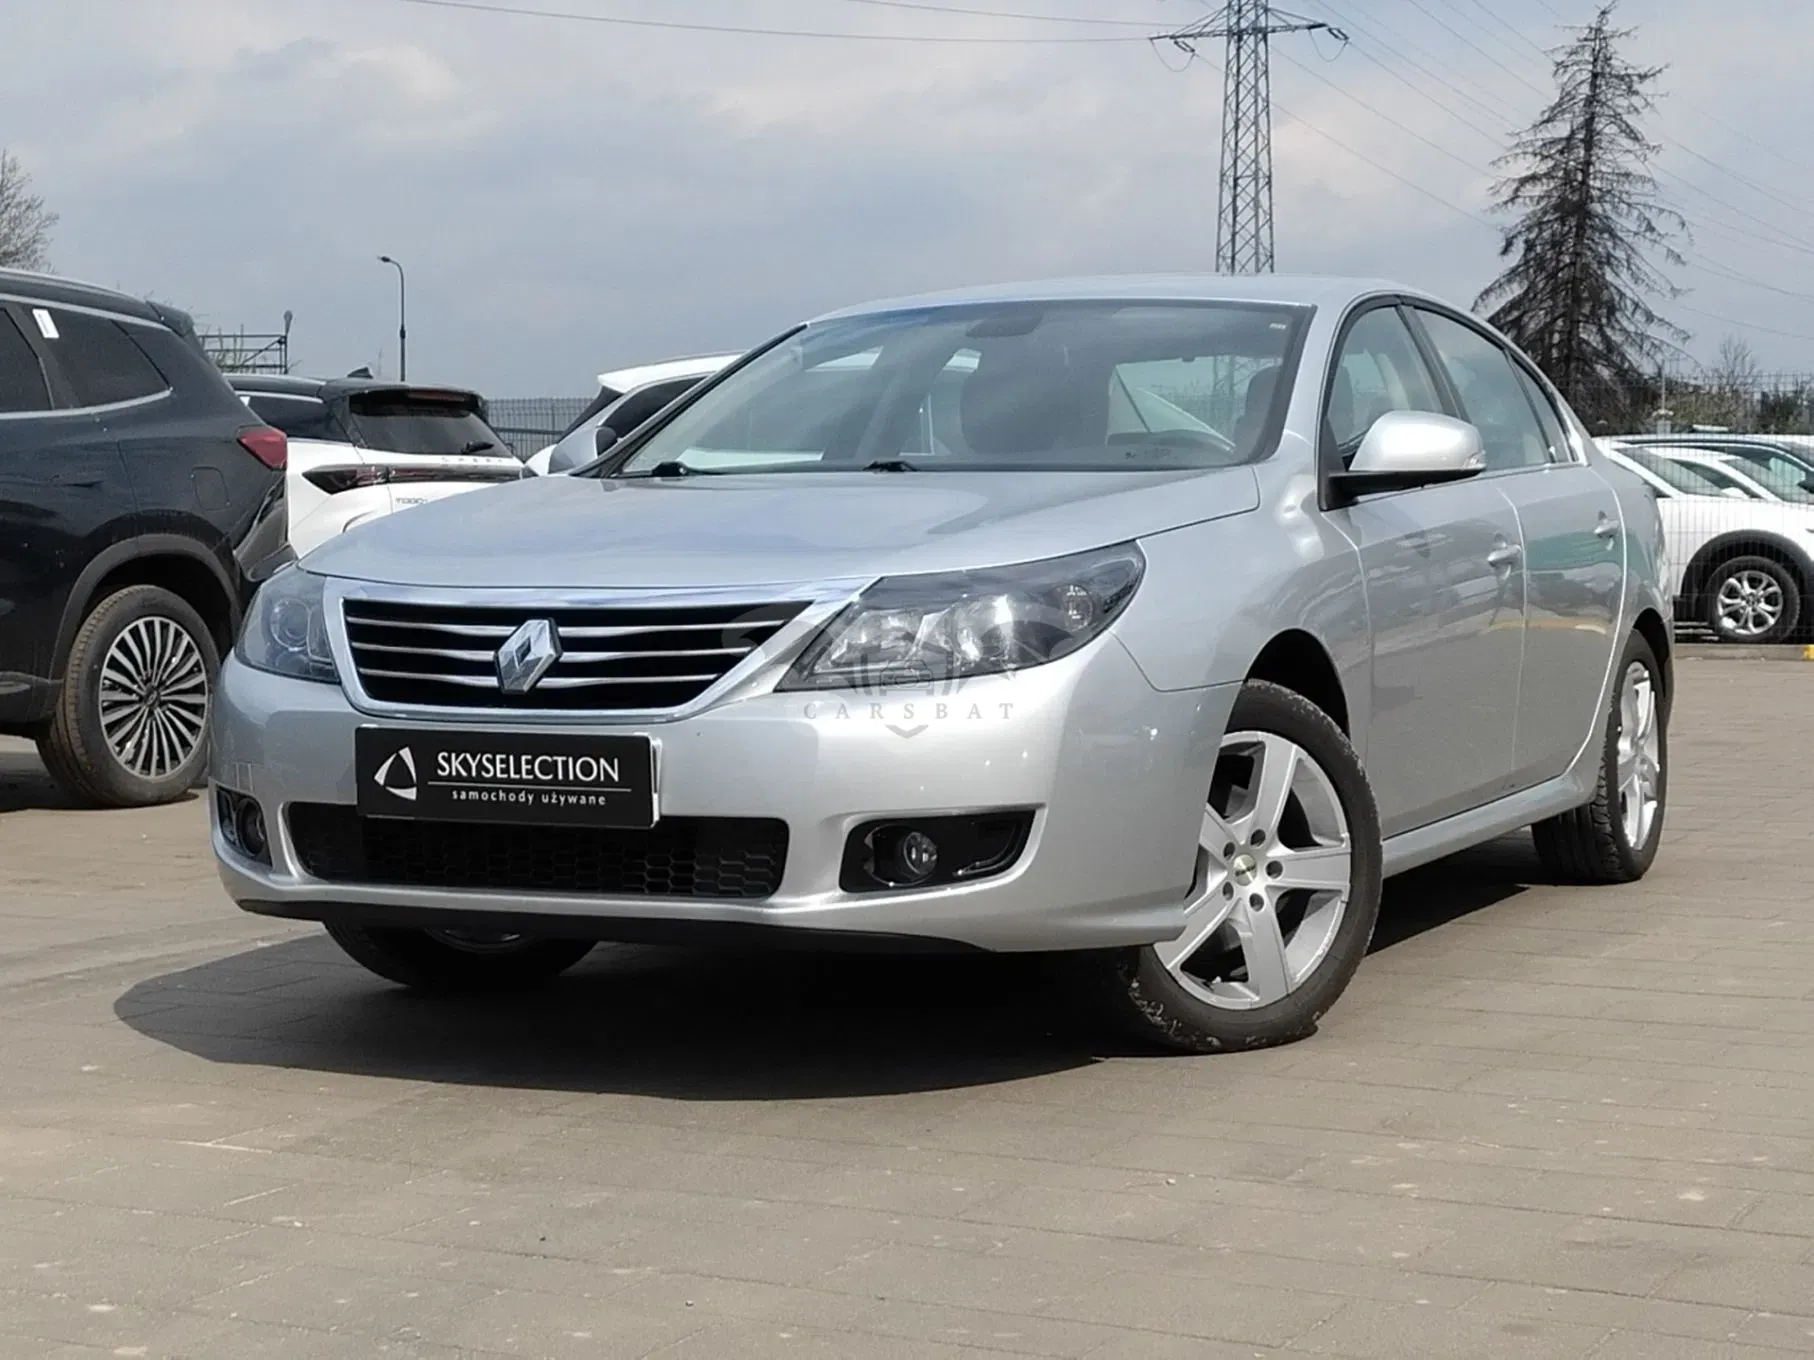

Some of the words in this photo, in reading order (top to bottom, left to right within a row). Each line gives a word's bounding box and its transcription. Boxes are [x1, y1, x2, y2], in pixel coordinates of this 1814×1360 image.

[437, 751, 619, 782] SKYSELECTION
[452, 790, 534, 805] samochody
[541, 791, 606, 805] używane
